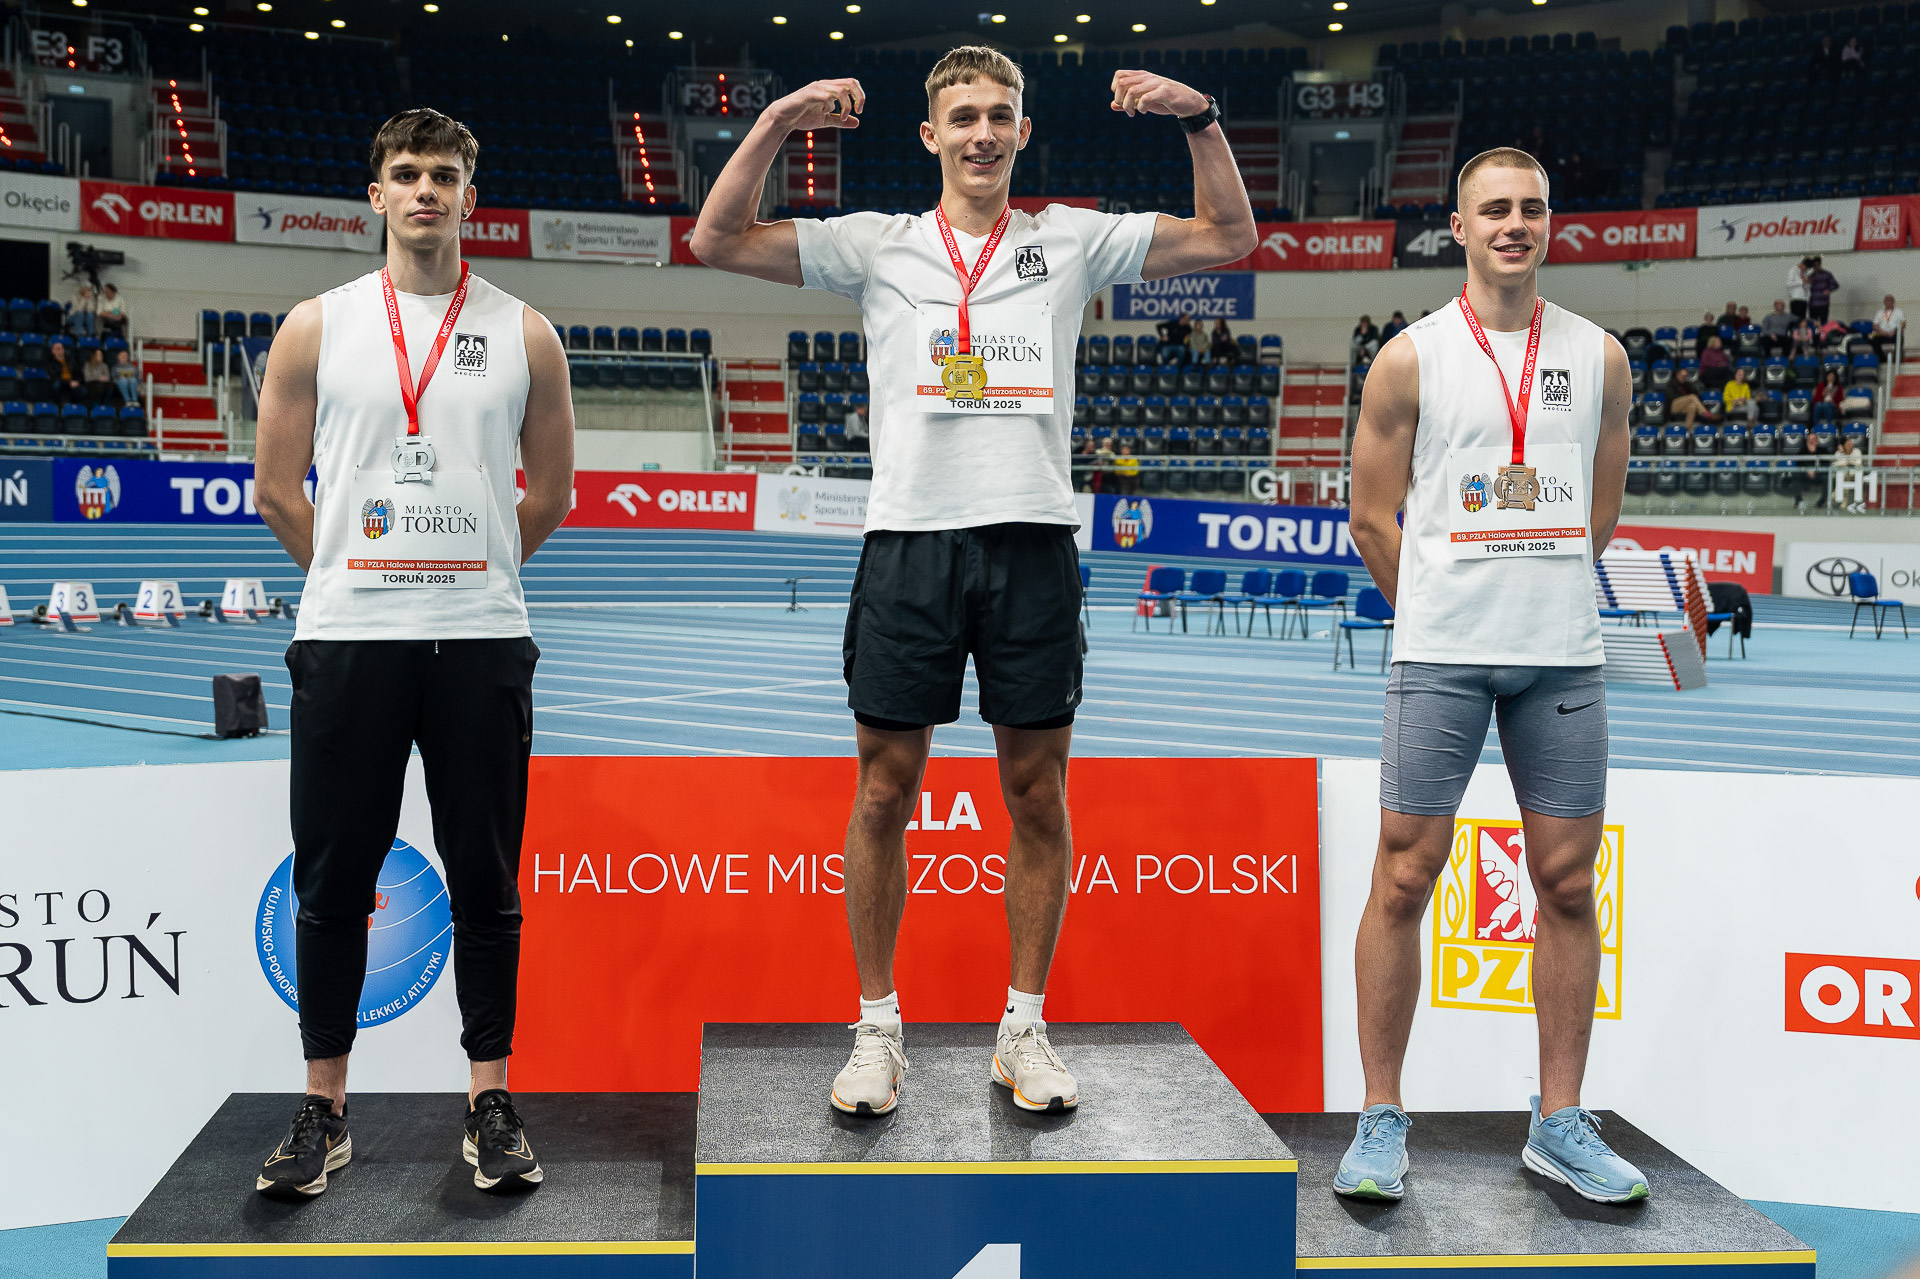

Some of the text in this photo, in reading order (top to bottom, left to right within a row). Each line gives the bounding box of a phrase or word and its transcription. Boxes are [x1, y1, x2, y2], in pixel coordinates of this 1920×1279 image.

[32, 30, 123, 65] E3 F3
[685, 83, 766, 109] F3 G3
[1298, 83, 1384, 110] G3 H3
[5, 191, 71, 213] Okęcie
[139, 200, 224, 225] ORLEN
[280, 212, 368, 235] polanik
[461, 221, 521, 243] RLEN
[577, 222, 639, 235] Ministerstwo
[1744, 214, 1843, 243] polanik
[577, 234, 608, 247] Sportu
[616, 235, 659, 248] Turystyki
[1602, 223, 1686, 246] ORLEN
[1305, 235, 1384, 255] ORLEN
[1130, 277, 1221, 296] KUJAWY
[1130, 298, 1237, 317] POMORZE
[971, 335, 1026, 345] MIASTO
[457, 349, 484, 360] AZS
[970, 342, 1043, 362] TORUŃ
[457, 358, 484, 368] AWF
[1521, 375, 1533, 395] 2025
[1544, 385, 1569, 394] AZS
[950, 398, 1022, 409] TORUŃ 2025
[1544, 393, 1569, 402] AWF
[1250, 469, 1291, 500] G1
[1320, 470, 1350, 501] H
[1835, 470, 1878, 503] H1
[405, 505, 462, 515] MIASTO
[657, 489, 747, 513] ORLEN
[815, 504, 848, 516] Sportu
[401, 513, 478, 534] TORUŃ
[1488, 531, 1516, 539] Halowe
[1516, 530, 1560, 538] Mistrzostwa
[1484, 541, 1556, 553] TORUŃ 2025
[353, 560, 366, 568] 69.
[386, 561, 415, 569] Halowe
[462, 561, 483, 569] Polski
[1659, 546, 1756, 575] LEN
[382, 572, 456, 584] TORUŃ 2025
[76, 591, 89, 612] 3
[143, 589, 153, 609] 2
[163, 589, 175, 609] 2
[231, 587, 237, 606] 1
[248, 587, 257, 606] 1
[906, 791, 982, 831] LA
[534, 853, 749, 894] HALOWE
[1136, 854, 1298, 894] POLSKI
[262, 886, 443, 1022] KUJAWSKO-POMORS LEKKIEJ ATLETYKI
